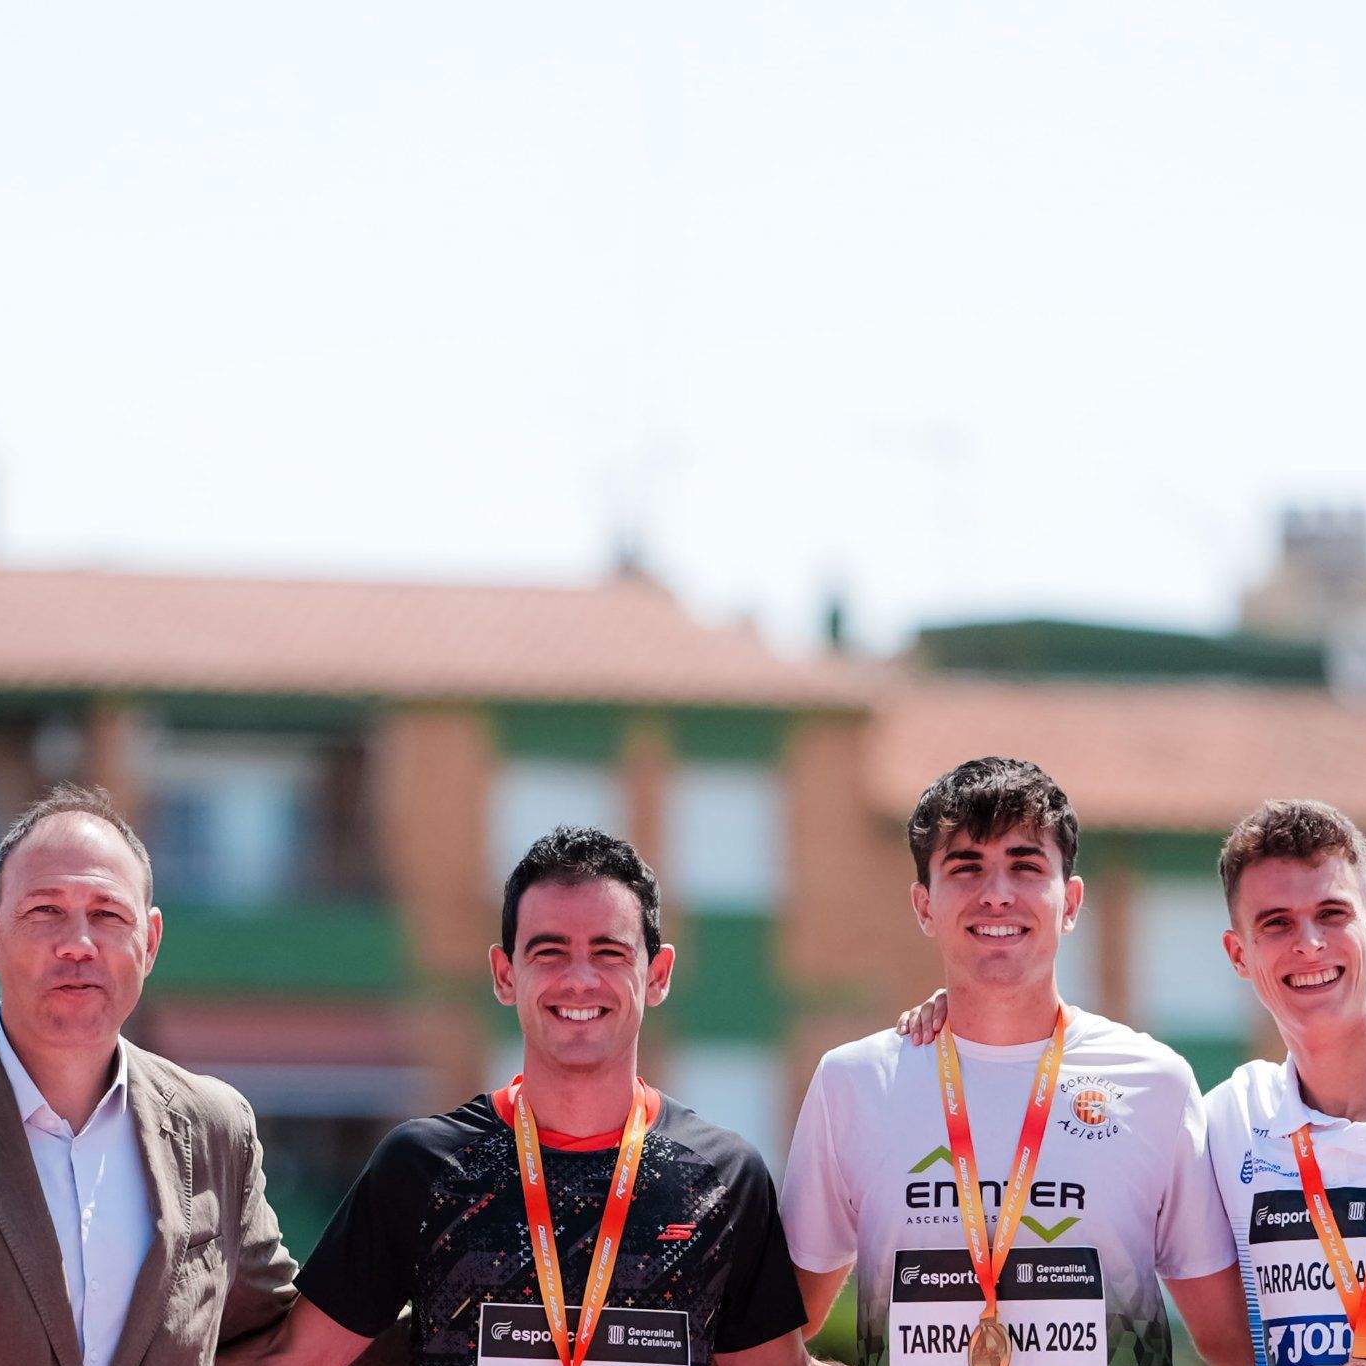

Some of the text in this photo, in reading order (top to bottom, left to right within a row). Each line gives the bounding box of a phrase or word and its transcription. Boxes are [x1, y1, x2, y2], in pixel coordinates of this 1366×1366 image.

[906, 1215, 998, 1225] ASCENSES
[1267, 1208, 1311, 1228] esport
[1036, 1264, 1087, 1274] Generalitat
[1036, 1273, 1095, 1284] de Catalunya
[1256, 1260, 1365, 1295] TARRAGOA
[628, 1327, 675, 1339] Generalitat
[898, 1322, 1097, 1354] TARRANA 2025
[627, 1338, 682, 1349] de Catalunya
